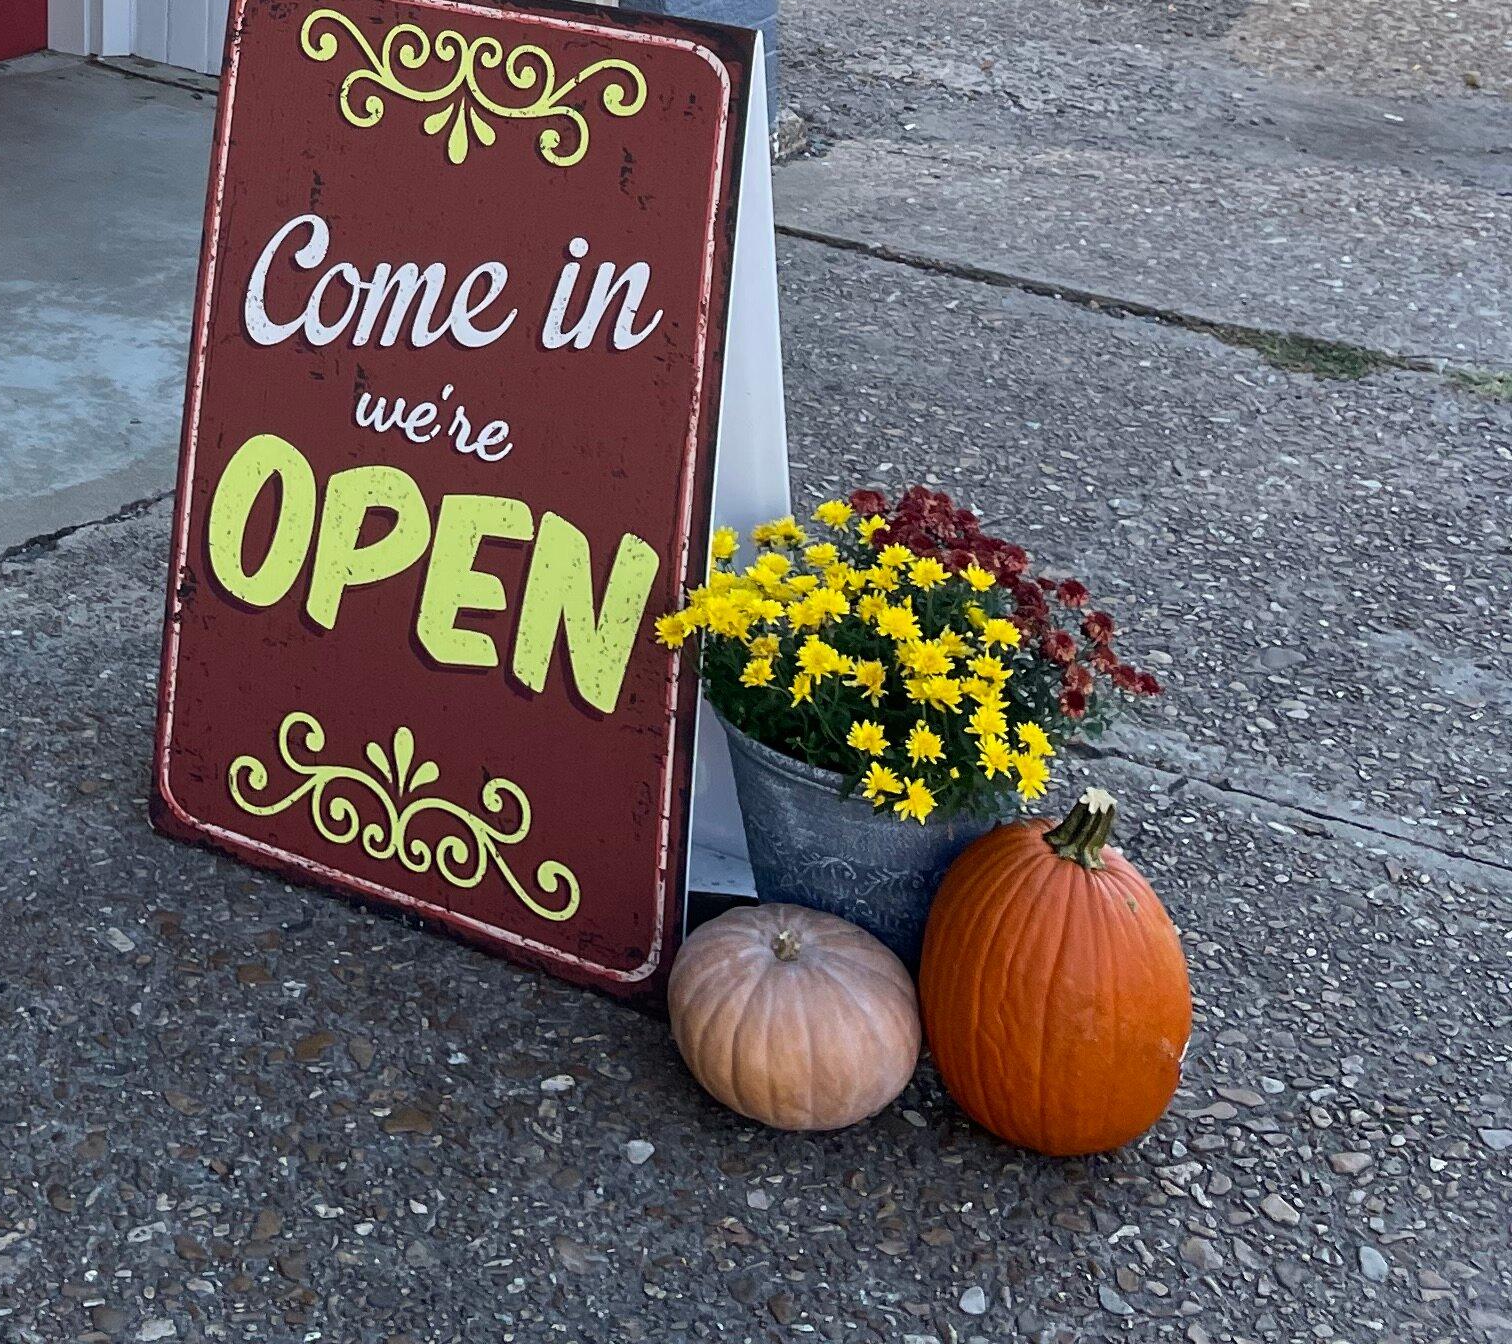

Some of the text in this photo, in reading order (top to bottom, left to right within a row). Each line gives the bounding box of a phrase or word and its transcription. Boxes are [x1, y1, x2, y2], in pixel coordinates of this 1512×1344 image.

[245, 214, 664, 352] Come in
[355, 383, 513, 462] we're
[210, 434, 659, 714] OPEN
